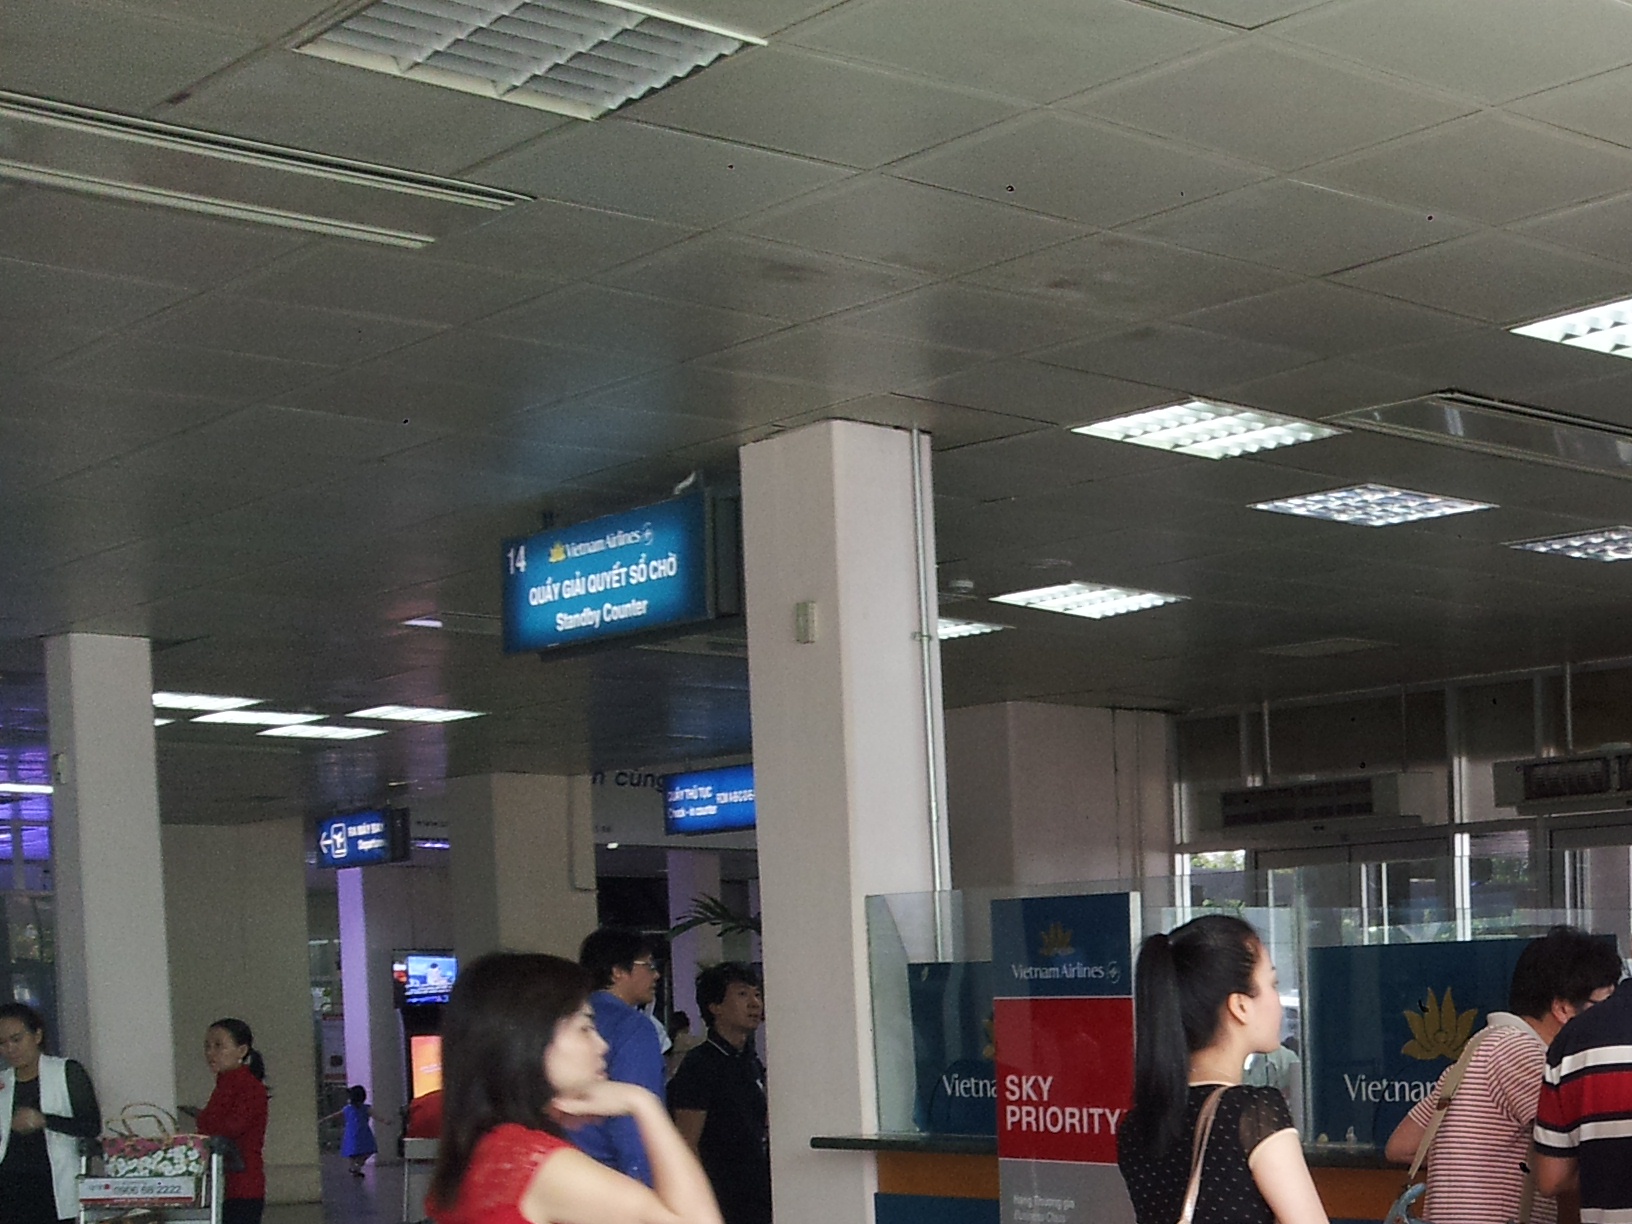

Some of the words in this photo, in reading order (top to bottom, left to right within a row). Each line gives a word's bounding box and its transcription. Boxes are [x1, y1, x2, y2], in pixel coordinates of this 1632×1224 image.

[507, 545, 527, 575] 14
[555, 606, 600, 632] Standby
[602, 598, 648, 623] Counter
[1011, 963, 1060, 980] Vietnam
[1061, 962, 1104, 979] Airlines
[942, 1073, 997, 1098] Vietna
[1005, 1075, 1053, 1101] SKY
[1006, 1105, 1121, 1135] PRIORITY
